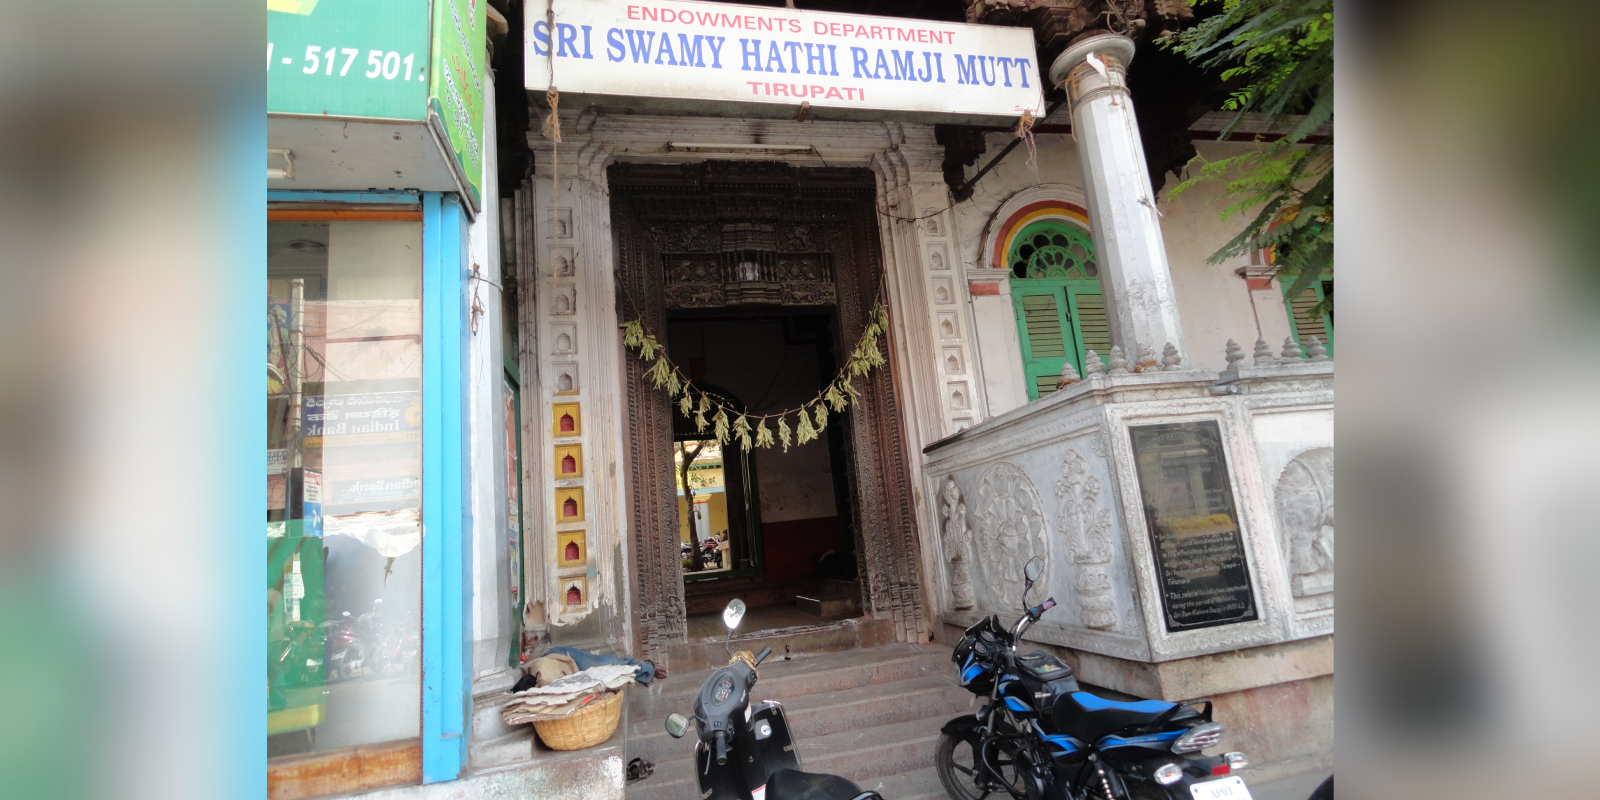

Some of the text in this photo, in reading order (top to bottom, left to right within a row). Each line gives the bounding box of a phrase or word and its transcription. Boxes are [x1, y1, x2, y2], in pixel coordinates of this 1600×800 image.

[627, 5, 956, 45] ENDOWMENTS DEPARTMENT
[302, 45, 359, 77] 517
[533, 20, 1031, 89] SRI SWAMY HATHI RAMJI MUTT
[746, 81, 865, 101] TIRUPATI
[1210, 786, 1234, 799] AP03
